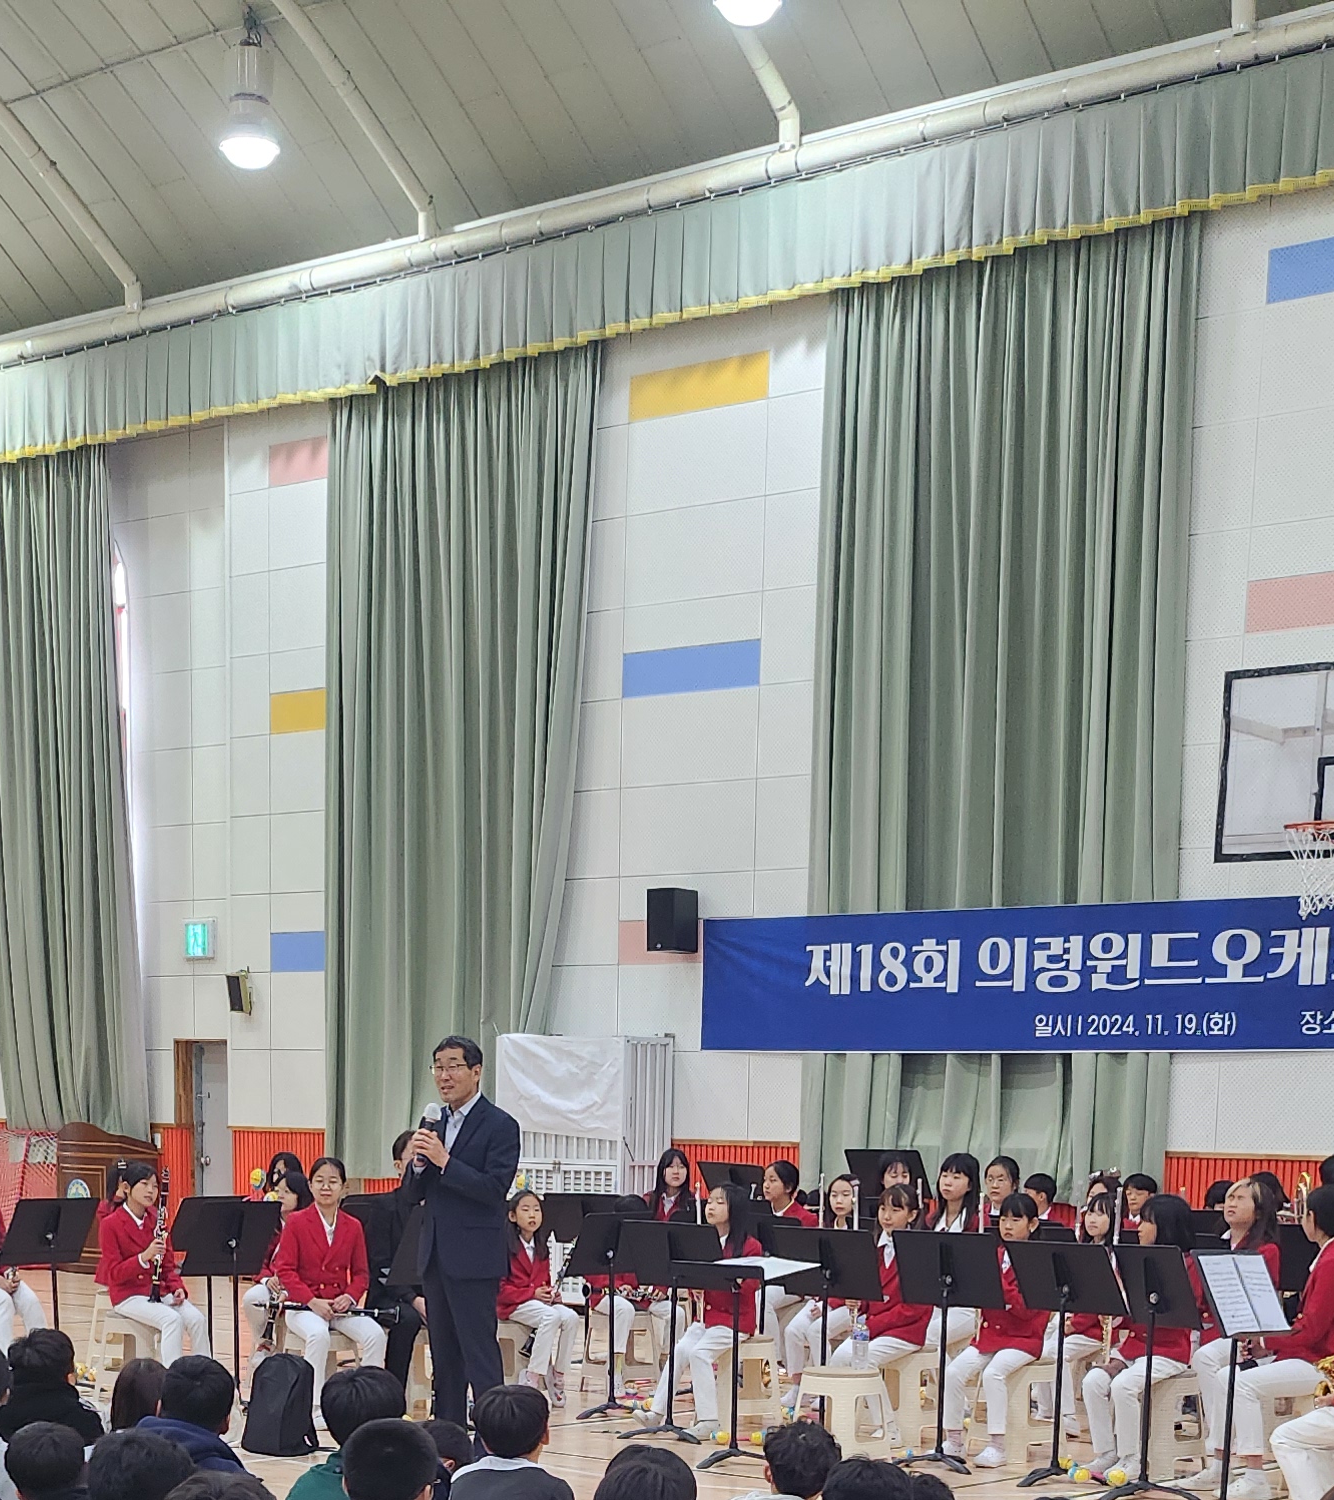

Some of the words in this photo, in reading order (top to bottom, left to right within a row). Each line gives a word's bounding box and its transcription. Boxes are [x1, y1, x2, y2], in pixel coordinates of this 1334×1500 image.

[804, 938, 961, 995] 제18회
[1034, 1014, 1072, 1038] 일시
[1087, 1014, 1140, 1037] 2024.
